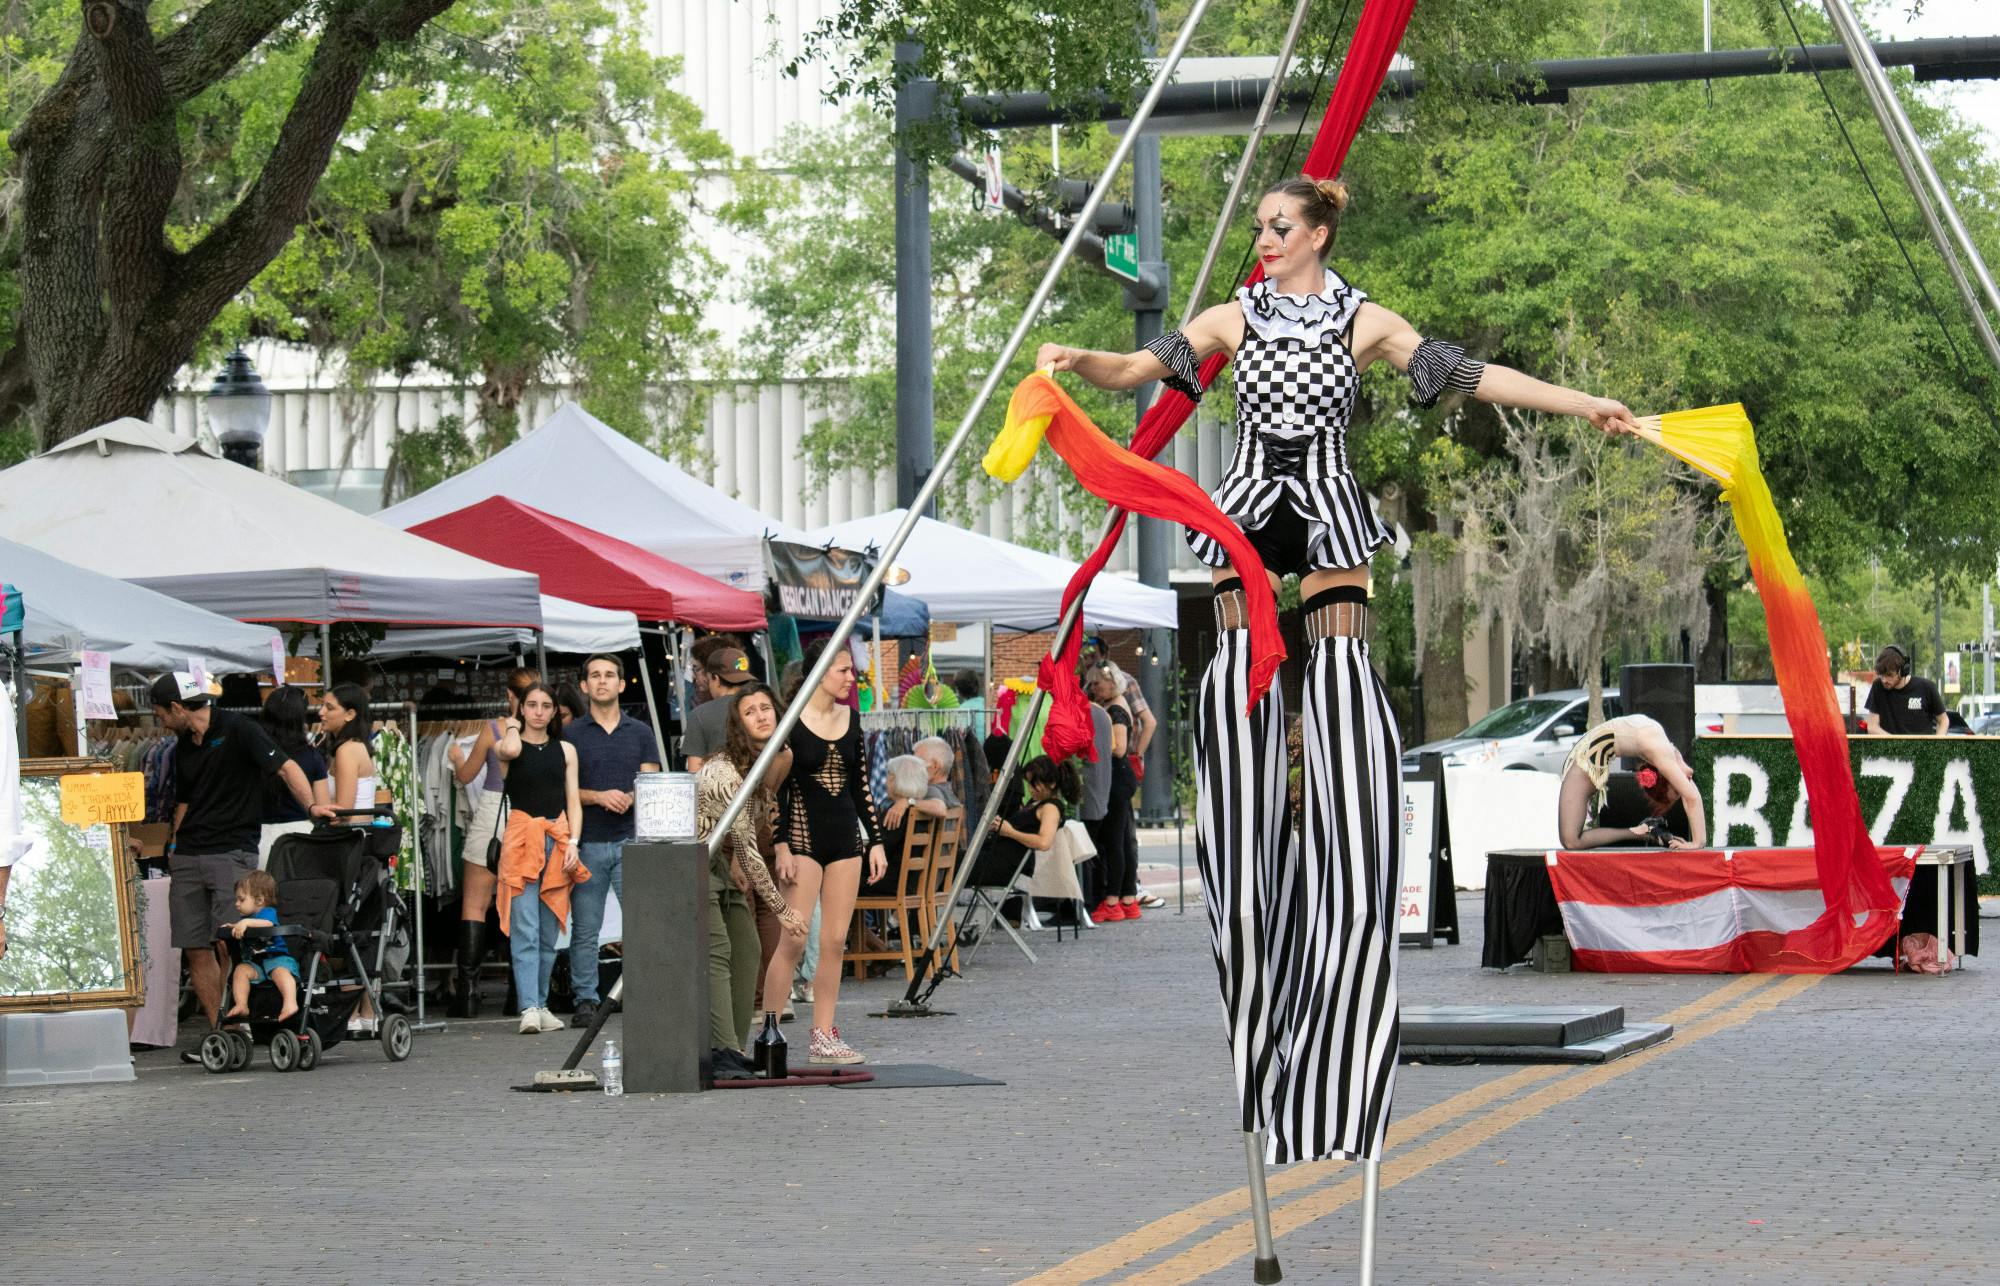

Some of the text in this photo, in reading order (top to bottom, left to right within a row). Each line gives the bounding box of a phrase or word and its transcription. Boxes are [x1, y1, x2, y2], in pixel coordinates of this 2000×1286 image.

[780, 584, 820, 615] ERICAN
[1403, 885, 1421, 893] ADE
[1400, 903, 1420, 917] SA
